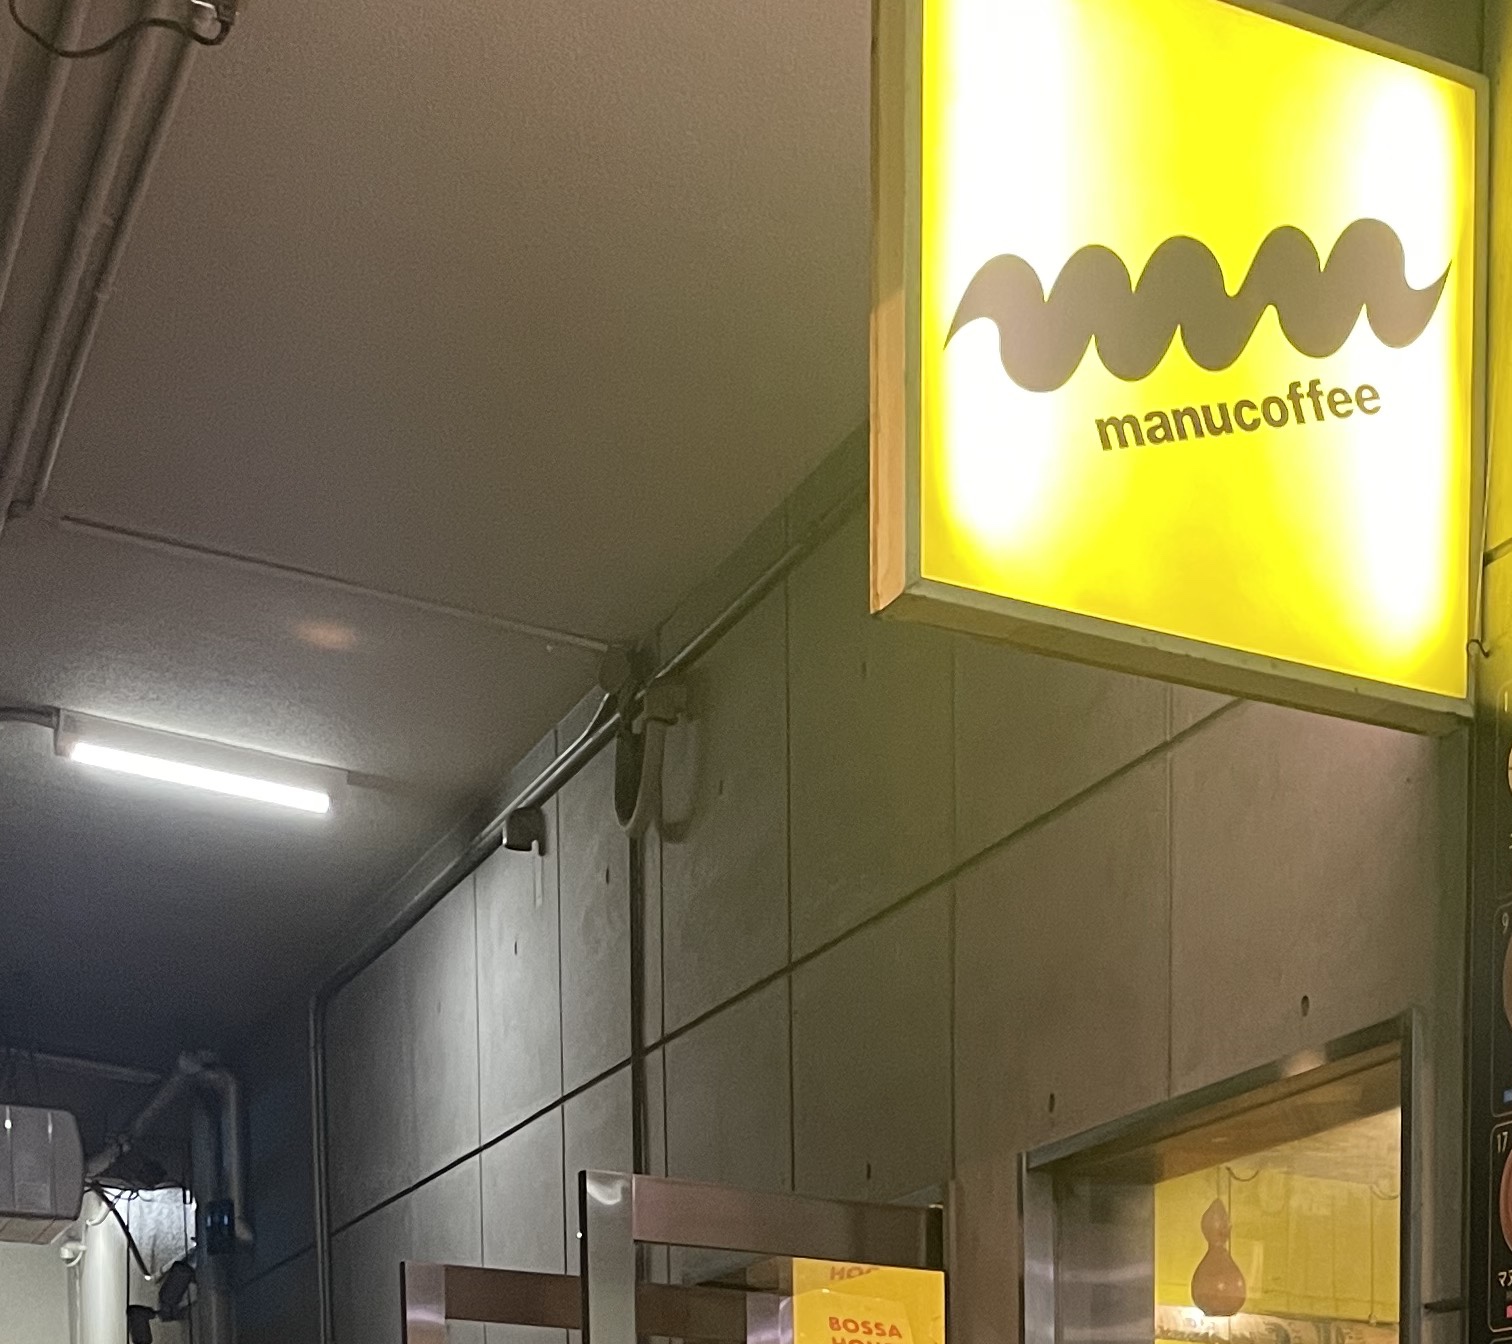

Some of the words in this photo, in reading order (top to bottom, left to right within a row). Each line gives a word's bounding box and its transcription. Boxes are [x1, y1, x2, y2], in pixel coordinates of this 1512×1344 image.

[1094, 376, 1382, 451] manucoffee
[1502, 913, 1510, 934] 9
[1497, 1132, 1508, 1153] 17
[828, 1316, 903, 1339] BOSSA
